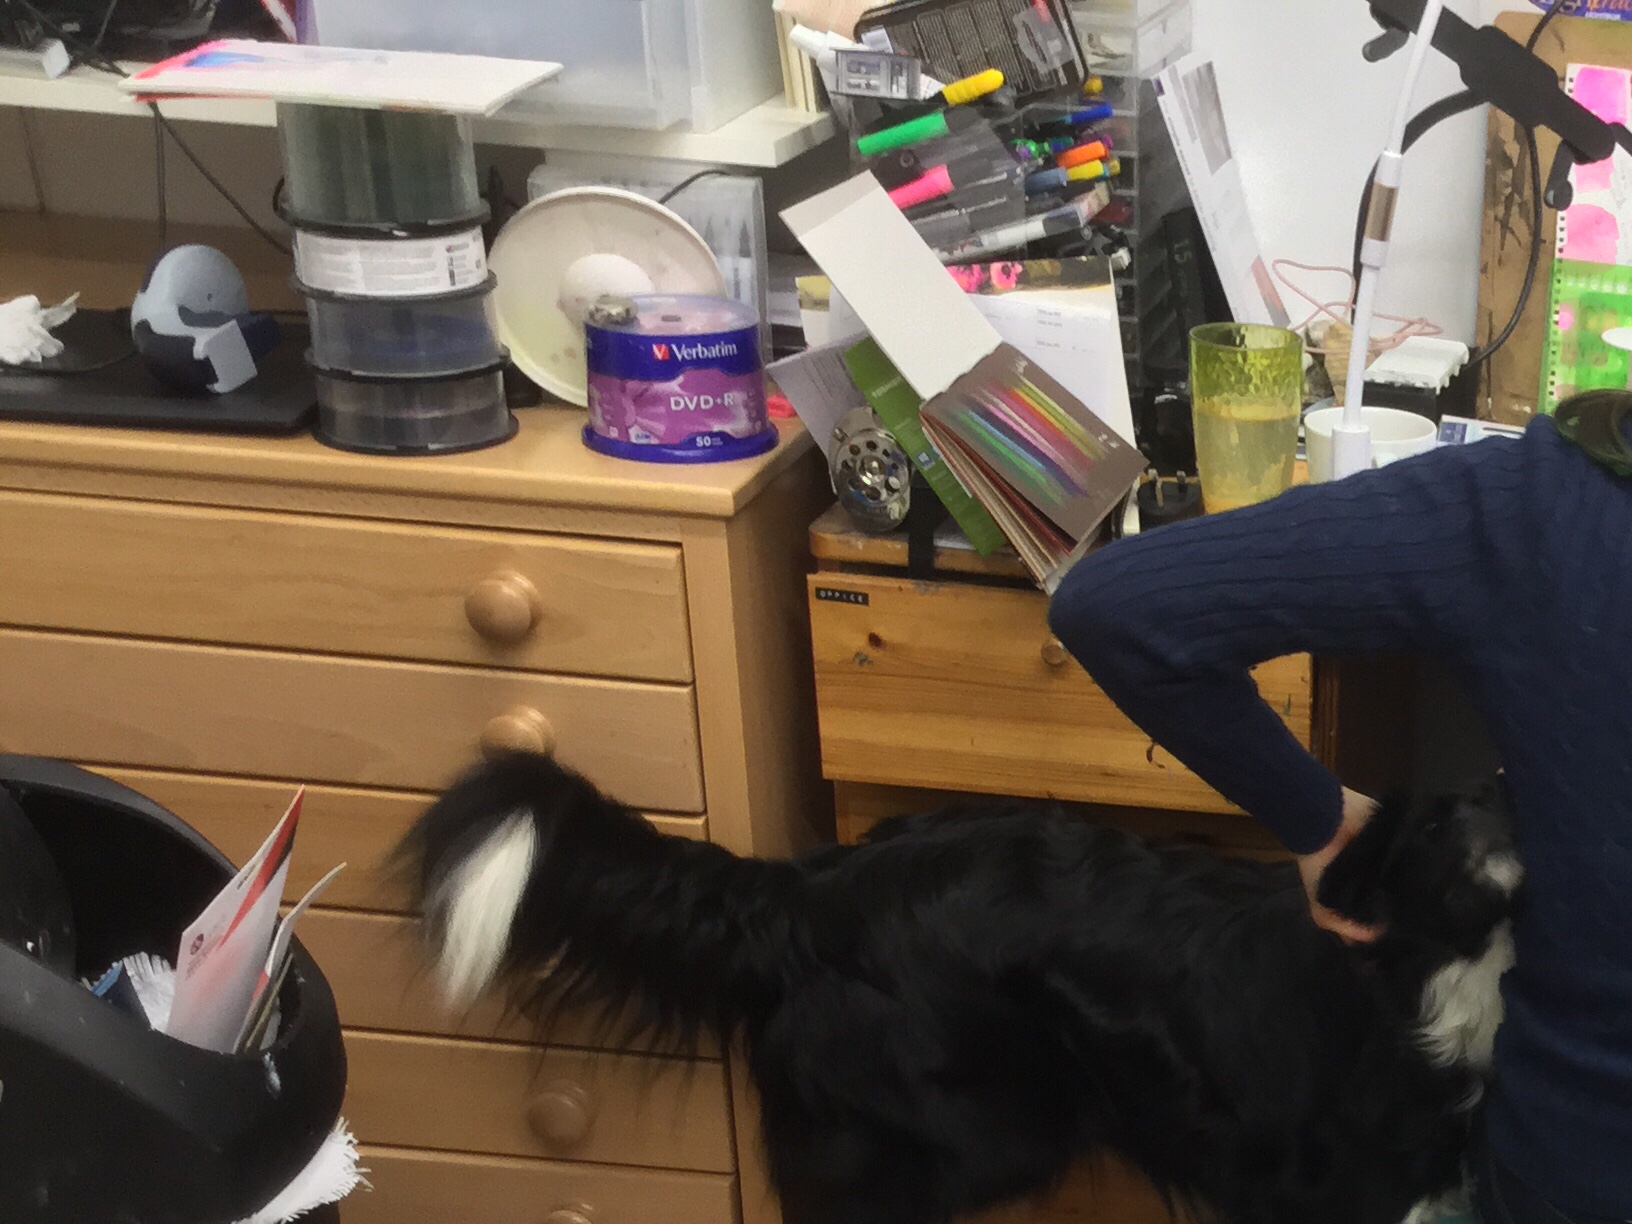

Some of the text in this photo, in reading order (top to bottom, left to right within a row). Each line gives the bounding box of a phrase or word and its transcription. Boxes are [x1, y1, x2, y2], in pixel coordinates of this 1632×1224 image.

[671, 342, 738, 362] Verbatim
[669, 392, 734, 411] DVD+R
[696, 435, 712, 447] 50
[819, 589, 863, 603] OFFICE
